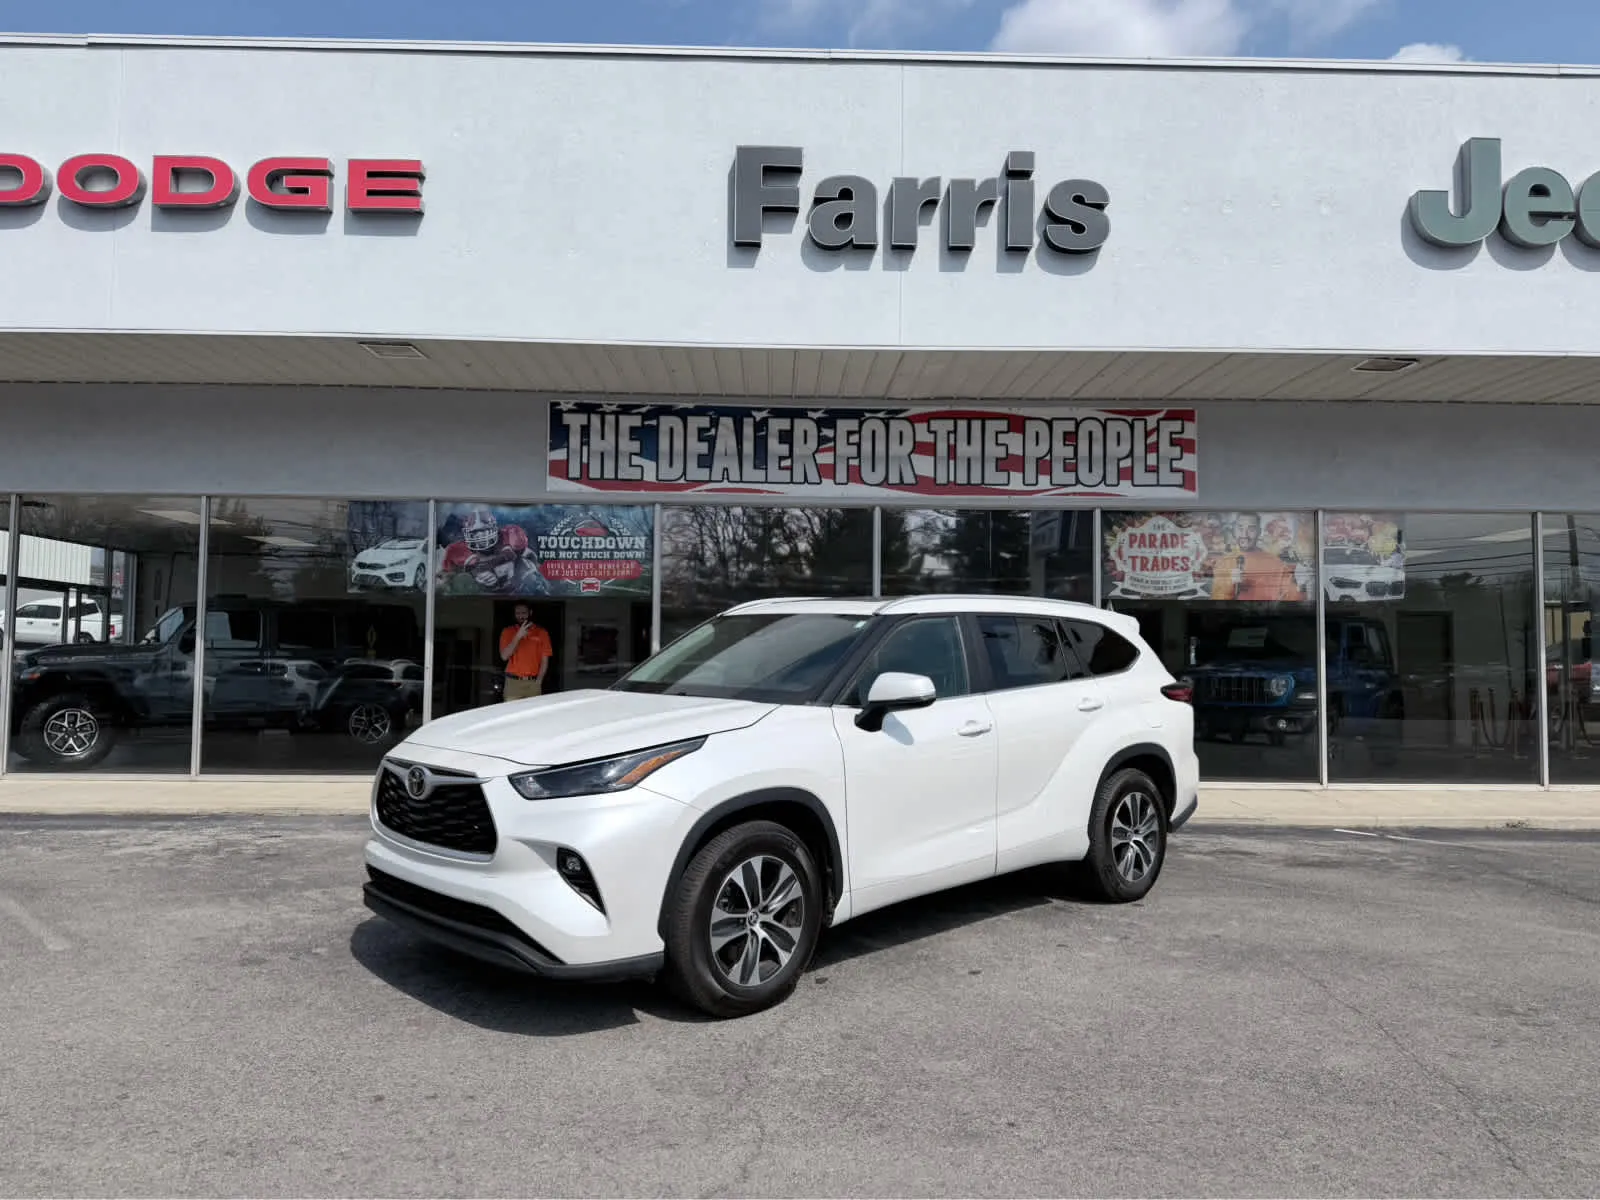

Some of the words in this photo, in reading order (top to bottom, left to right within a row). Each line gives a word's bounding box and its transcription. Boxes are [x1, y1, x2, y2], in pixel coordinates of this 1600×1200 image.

[734, 145, 1111, 253] Farris
[1409, 137, 1600, 247] Je
[562, 412, 643, 481] THE
[656, 415, 822, 485] DEALER
[834, 416, 918, 486] FOR
[928, 417, 1010, 486] THE
[1023, 417, 1185, 487] PEOPLE
[538, 536, 647, 549] TOUCHDOWN
[1128, 533, 1190, 549] PARADE
[539, 551, 556, 559] FOR
[559, 551, 579, 559] NOT
[582, 551, 610, 559] MUCH
[613, 551, 646, 559] DOWN!
[1128, 556, 1191, 572] TRADES
